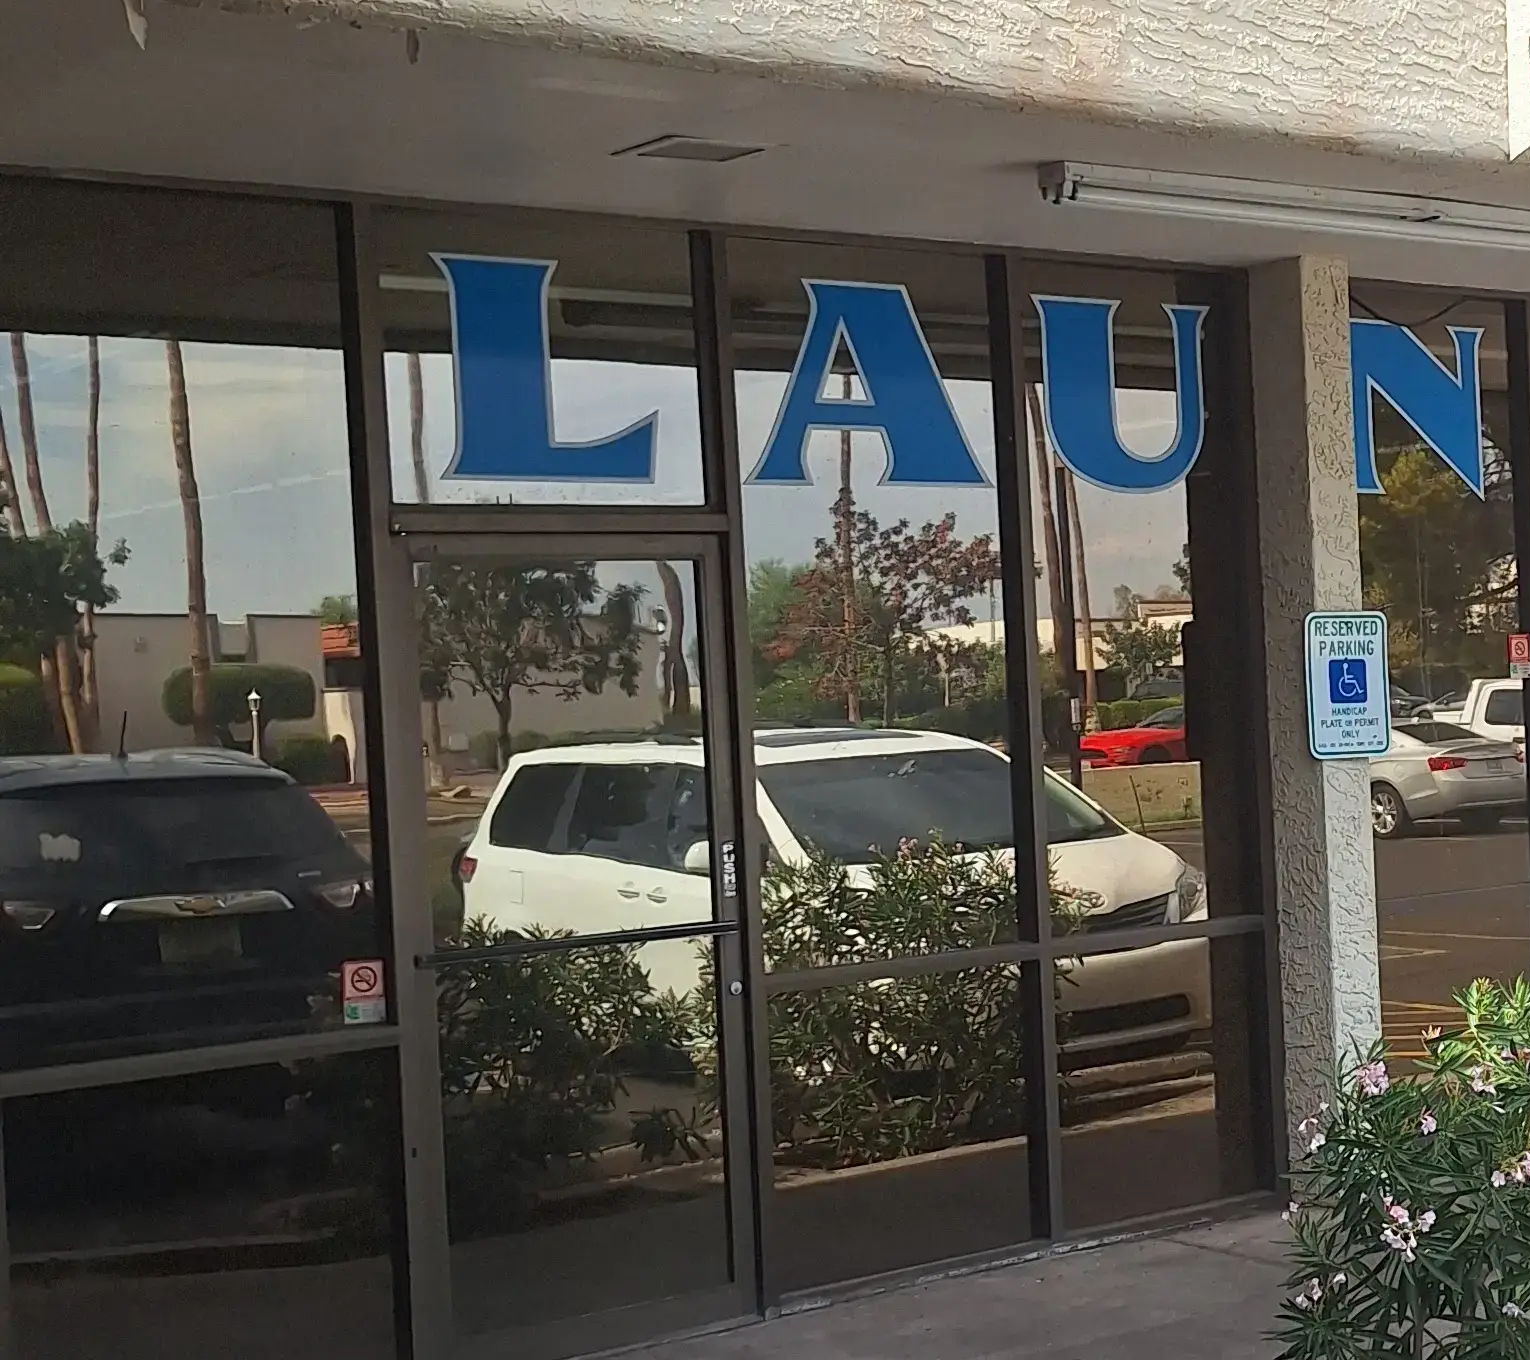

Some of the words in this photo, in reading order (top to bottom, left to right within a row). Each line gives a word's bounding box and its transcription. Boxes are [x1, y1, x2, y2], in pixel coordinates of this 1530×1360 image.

[1314, 620, 1378, 637] RESERVED
[1319, 640, 1375, 656] PARKING
[1332, 707, 1367, 717] HANDICAP
[1321, 719, 1342, 728] PLATE
[1355, 718, 1379, 727] PERMIT
[1342, 730, 1359, 738] ONLY
[722, 843, 736, 884] PUSH
